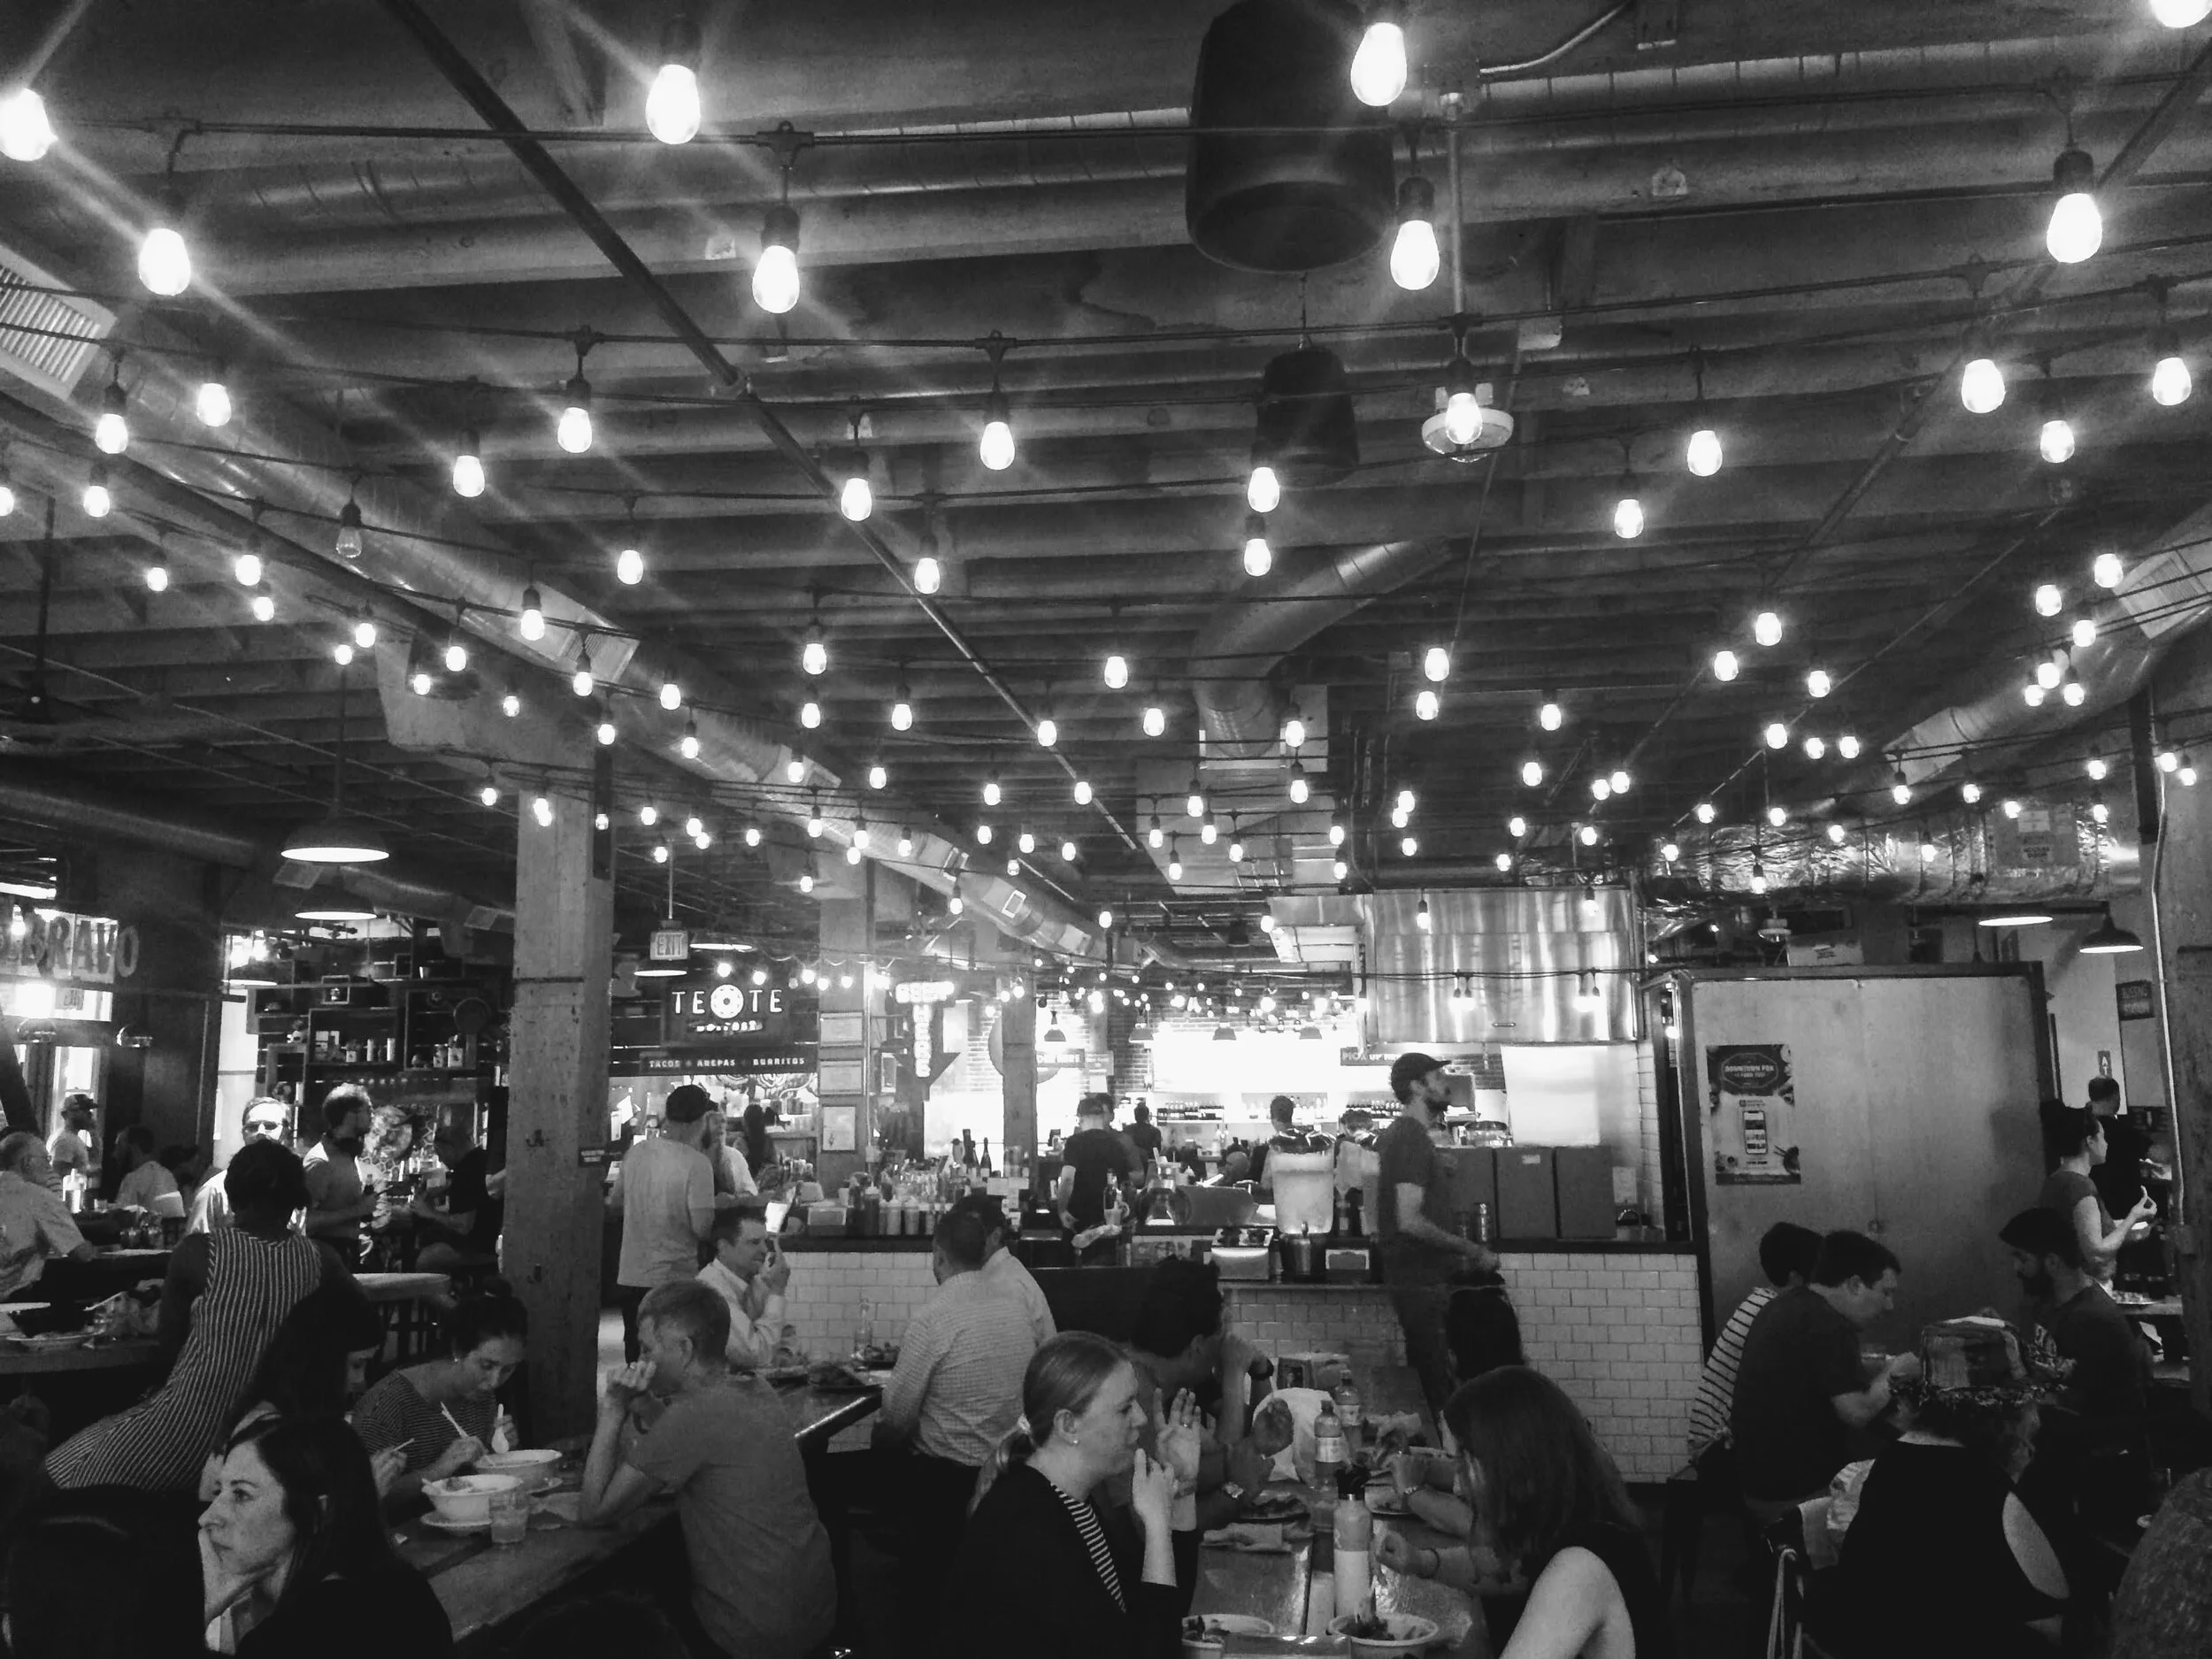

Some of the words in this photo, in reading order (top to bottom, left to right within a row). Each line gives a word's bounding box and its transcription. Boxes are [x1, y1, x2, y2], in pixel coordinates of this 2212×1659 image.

[657, 933, 683, 956] EXIT
[672, 984, 783, 1018] TEOTE
[753, 1057, 805, 1066] BURRITOS
